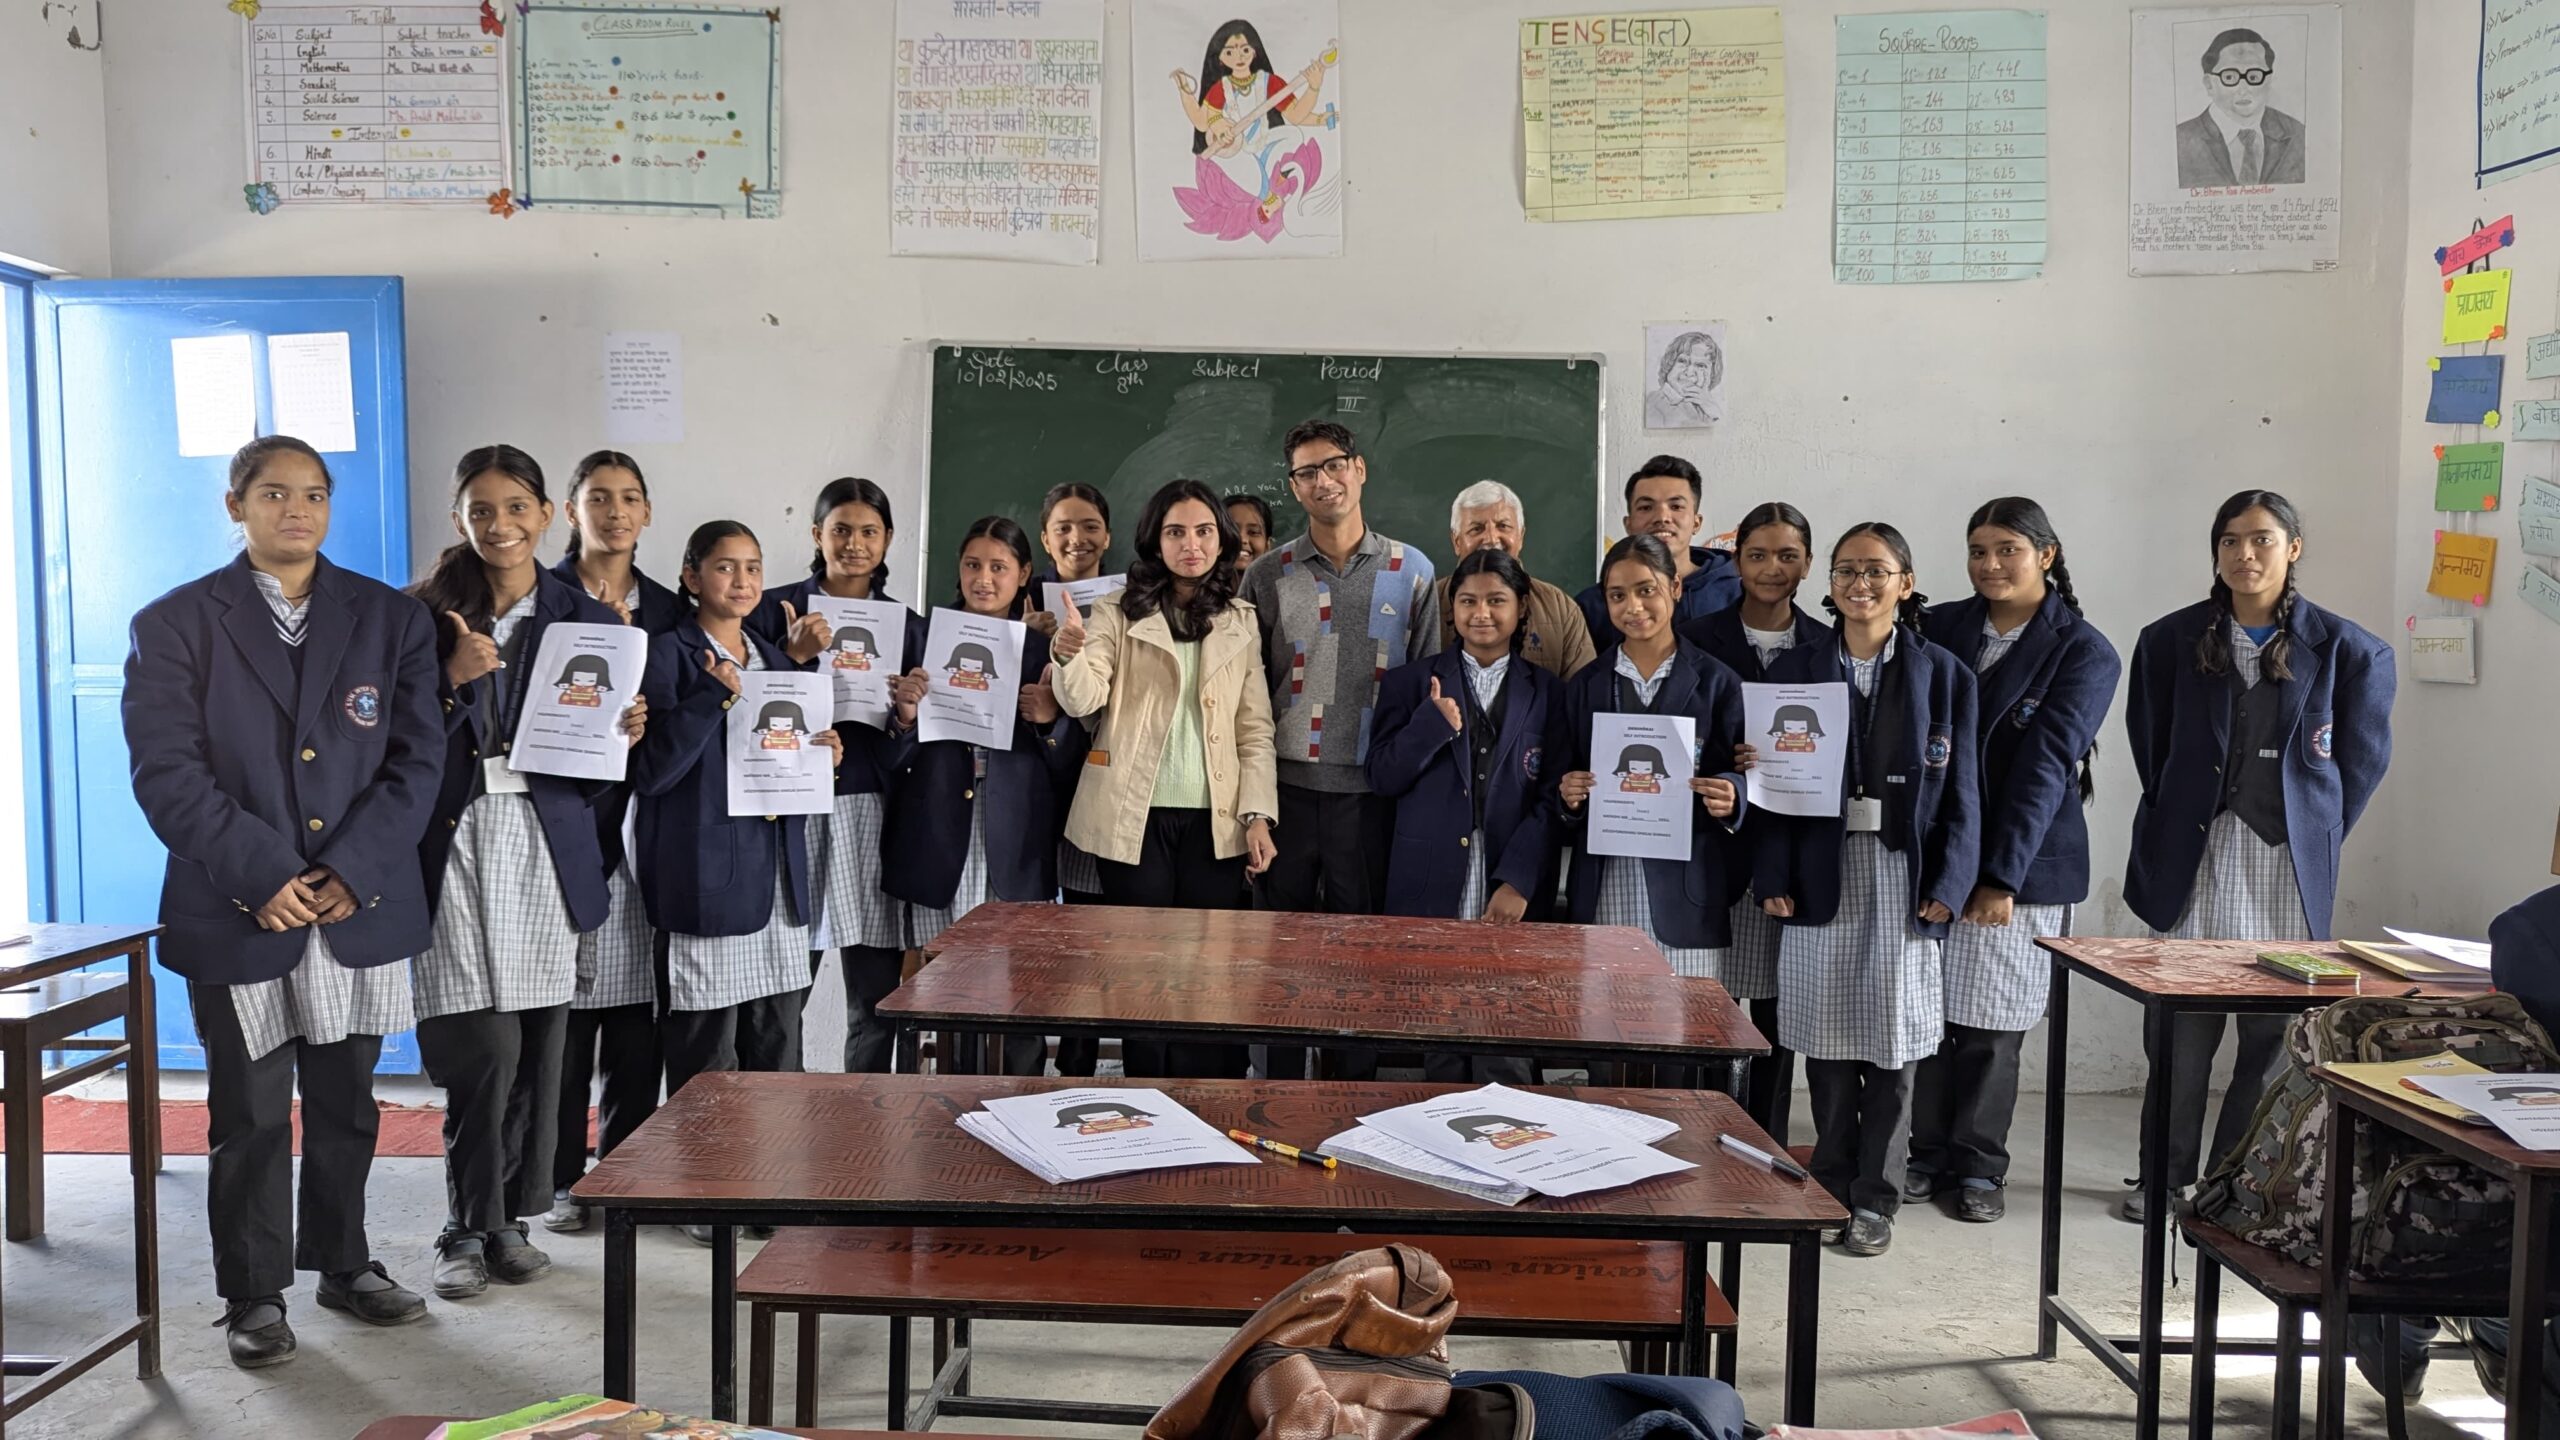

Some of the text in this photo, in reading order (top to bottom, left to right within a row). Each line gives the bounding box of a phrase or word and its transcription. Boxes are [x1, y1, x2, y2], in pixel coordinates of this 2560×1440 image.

[295, 27, 332, 45] Subject
[296, 44, 327, 63] English
[1928, 67, 1947, 80] 121
[1996, 59, 2021, 77] 441
[1925, 90, 1943, 107] 144
[302, 109, 337, 121] Science
[347, 125, 398, 141] Interval
[1860, 165, 1876, 180] 25
[1993, 166, 2016, 180] 625
[967, 350, 1382, 382] Date Class Subject Period
[958, 366, 1144, 393] 10/02/2025 8th
[1224, 484, 1249, 496] ARE
[1252, 1085, 1307, 1097] the
